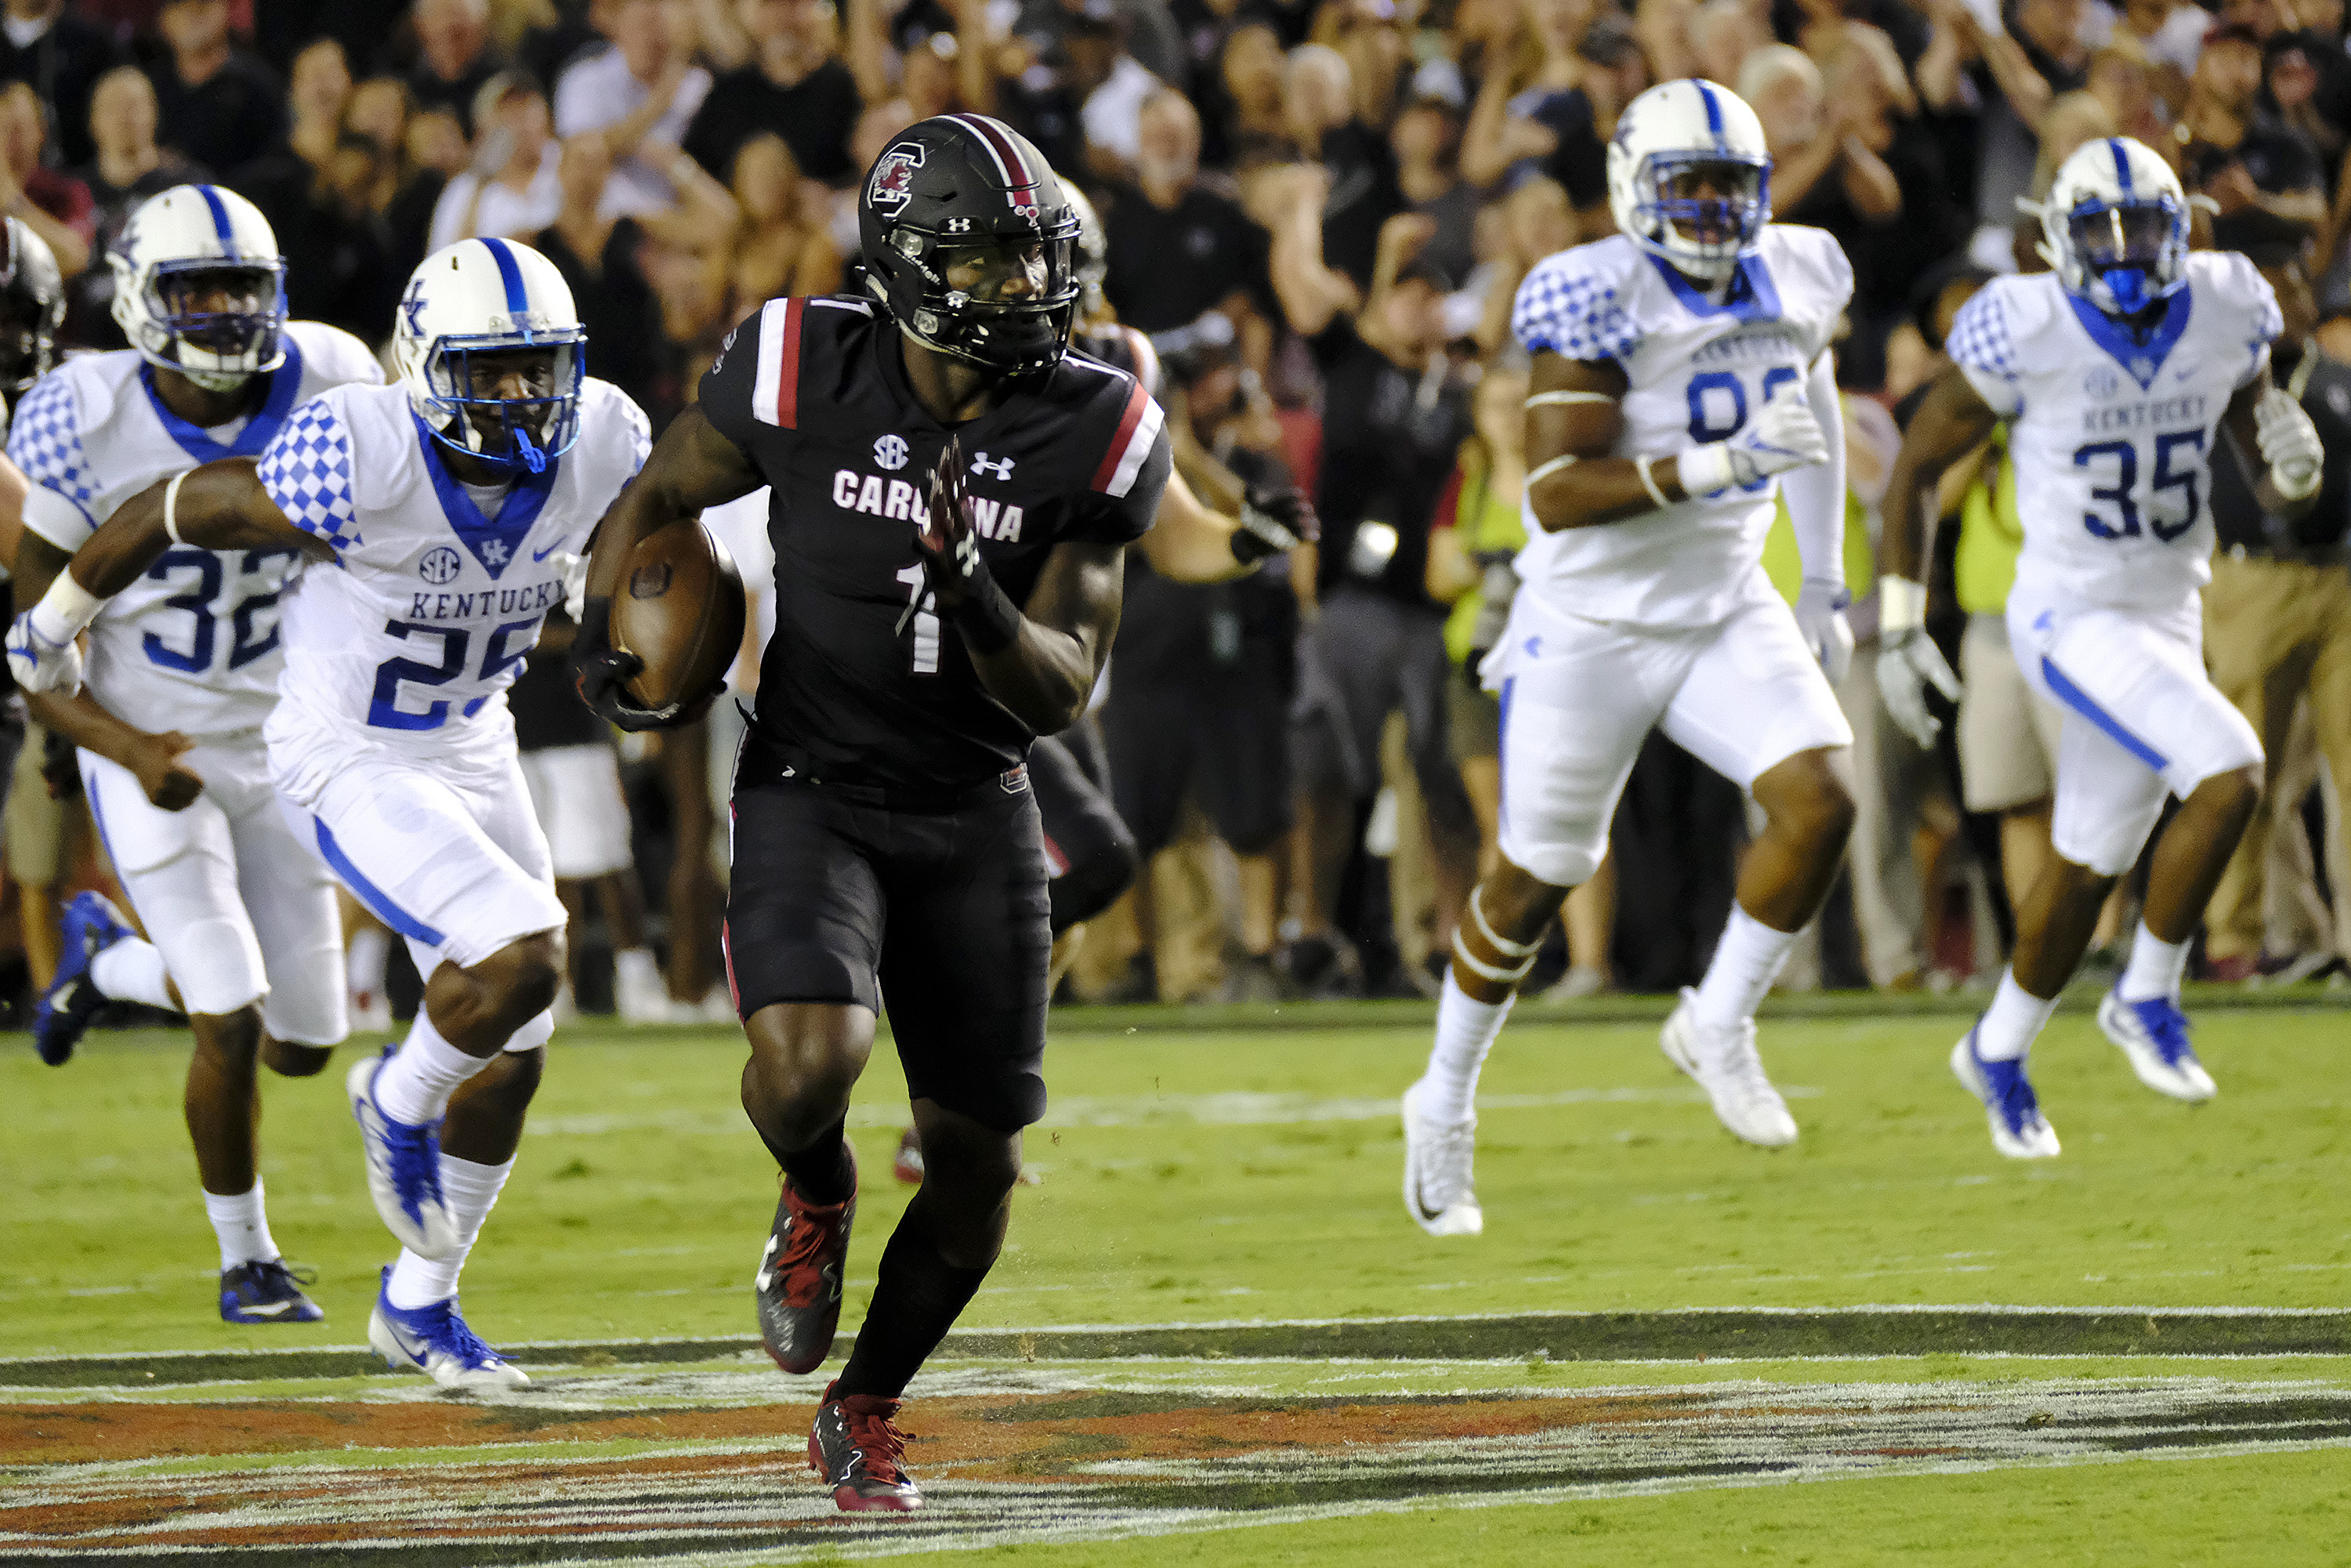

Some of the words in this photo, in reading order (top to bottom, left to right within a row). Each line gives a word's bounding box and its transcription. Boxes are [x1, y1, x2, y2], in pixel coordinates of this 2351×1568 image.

[873, 433, 910, 471] SEC
[2074, 425, 2206, 542] 35
[142, 549, 304, 674] 32
[419, 546, 462, 585] SEC
[896, 561, 940, 674] 1
